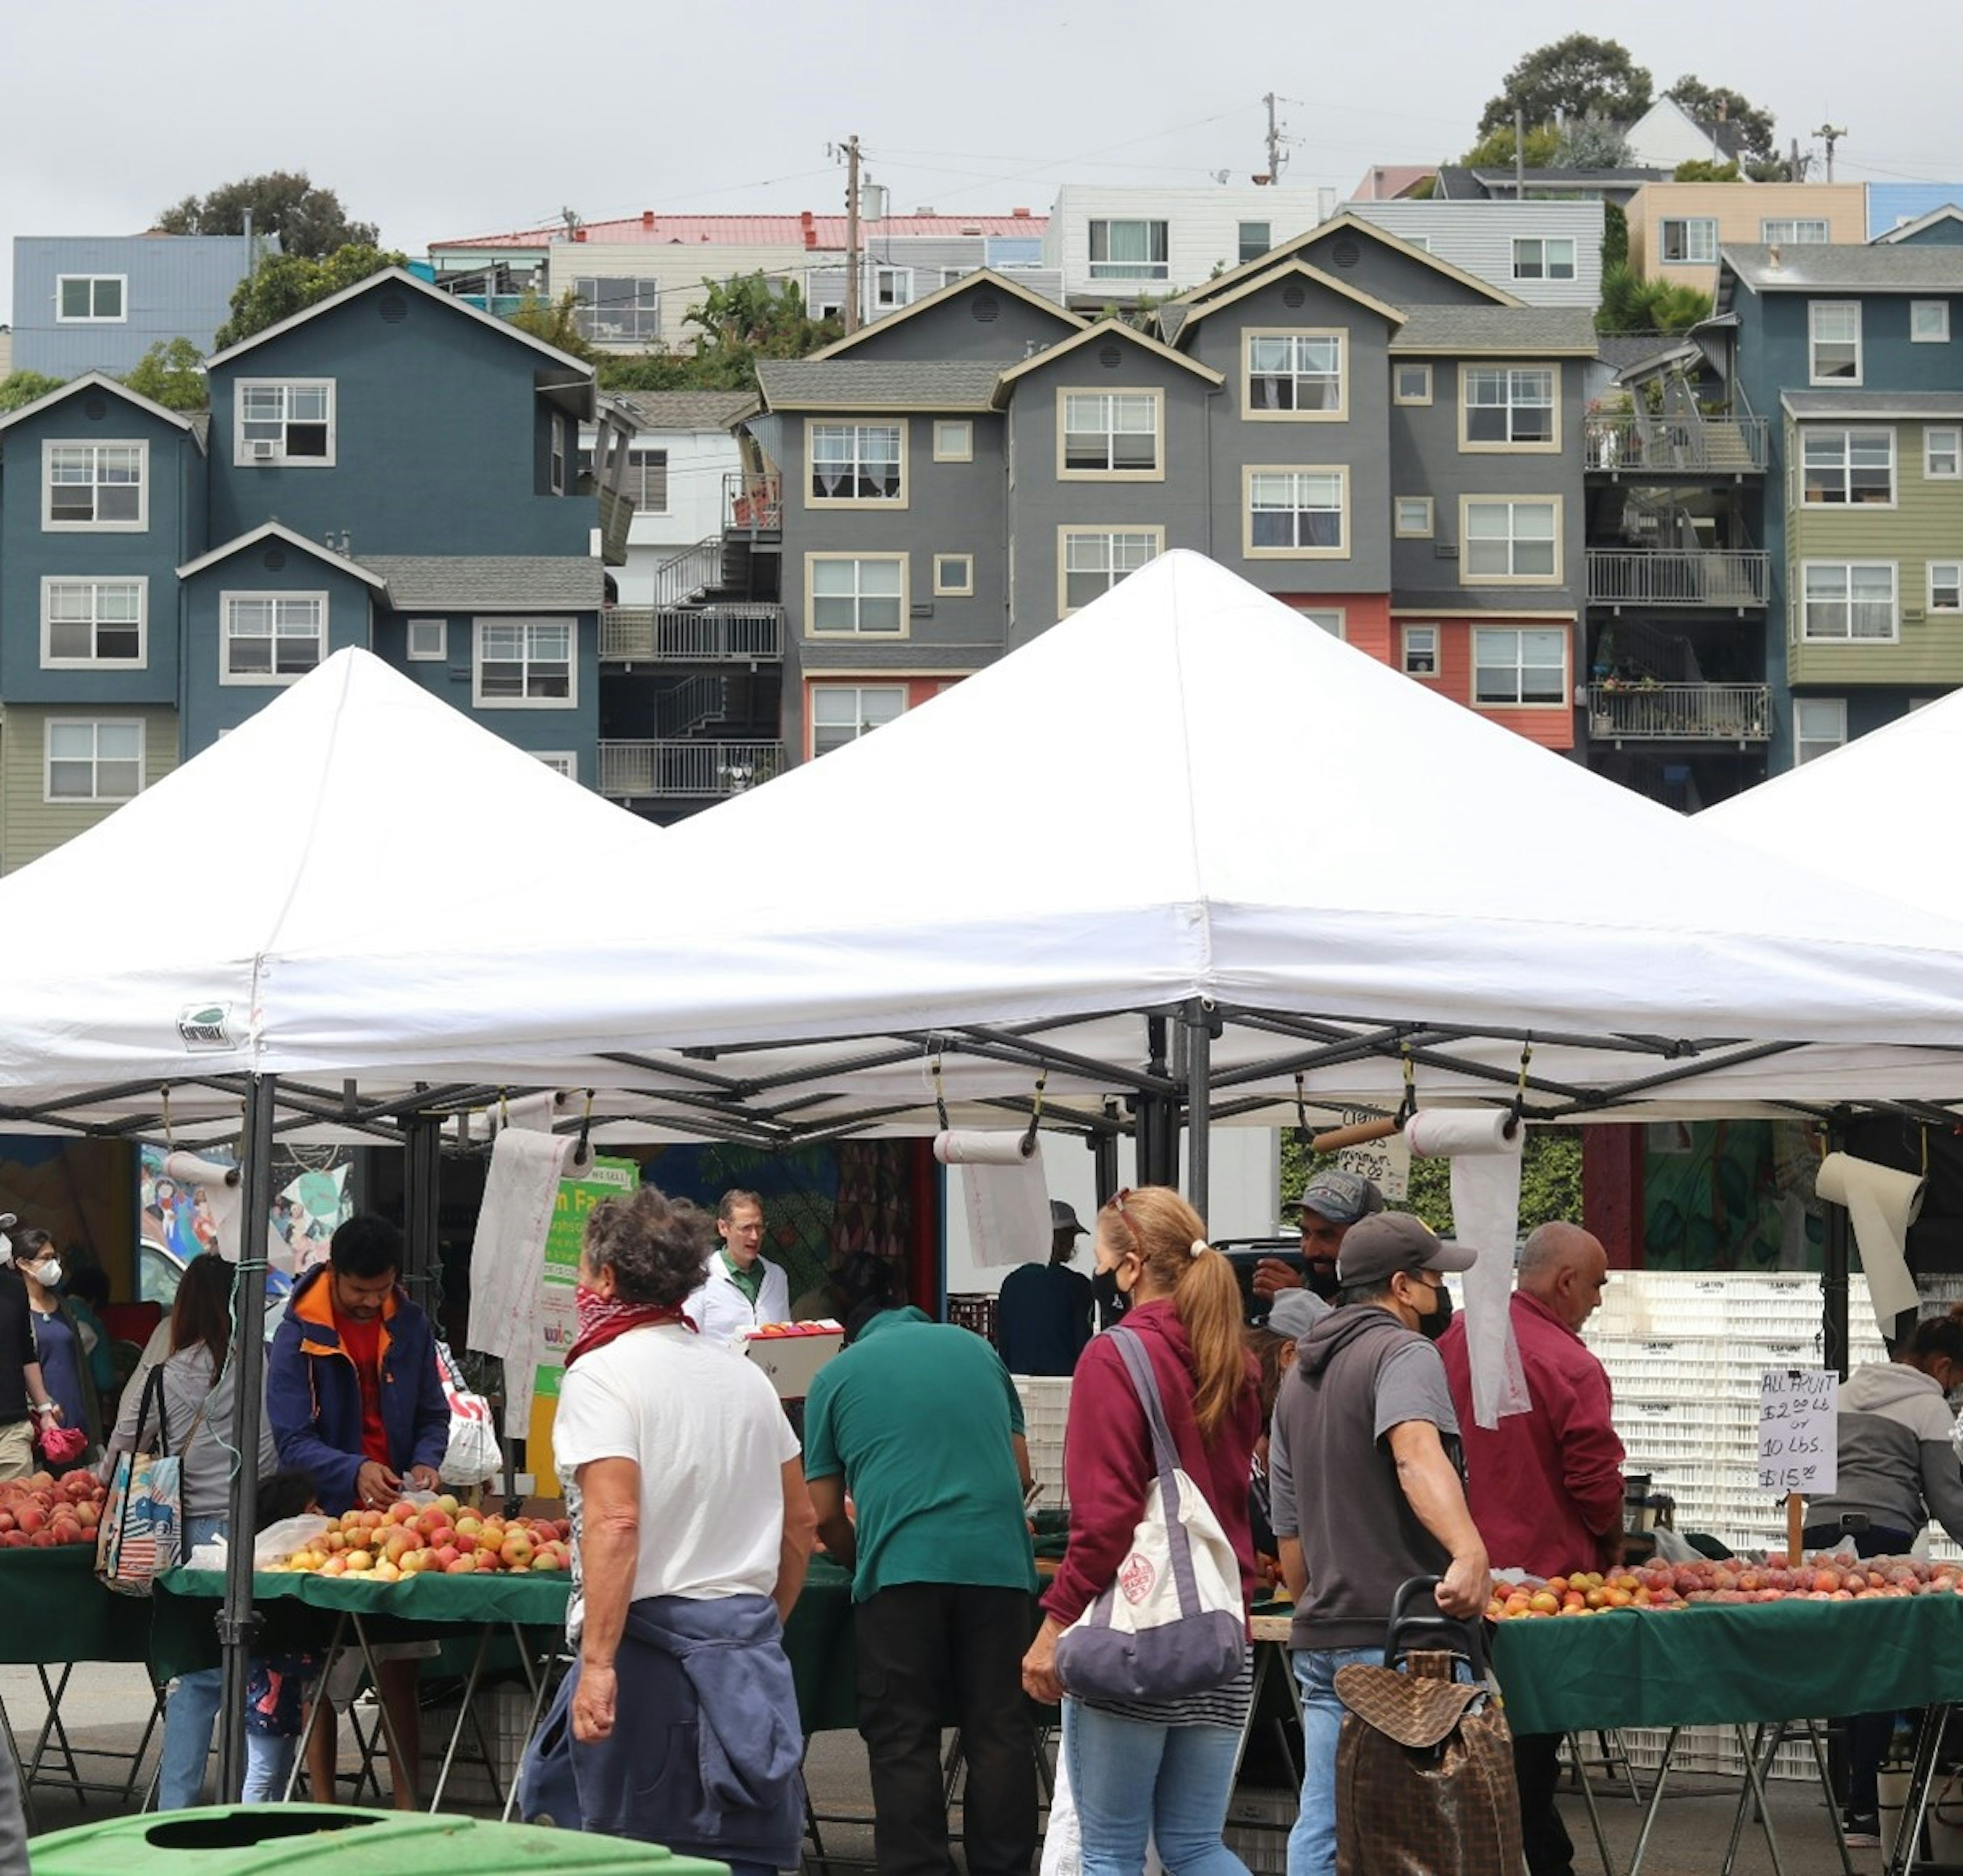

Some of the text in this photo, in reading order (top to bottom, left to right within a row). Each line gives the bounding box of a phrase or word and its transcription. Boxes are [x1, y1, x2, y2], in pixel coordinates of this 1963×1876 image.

[179, 1022, 224, 1040] Eurmax
[1340, 1149, 1391, 1166] minimum
[543, 1320, 573, 1345] wic
[1762, 1373, 1836, 1394] ALL FRUIT
[1790, 1418, 1810, 1429] or
[1761, 1438, 1783, 1457] 10
